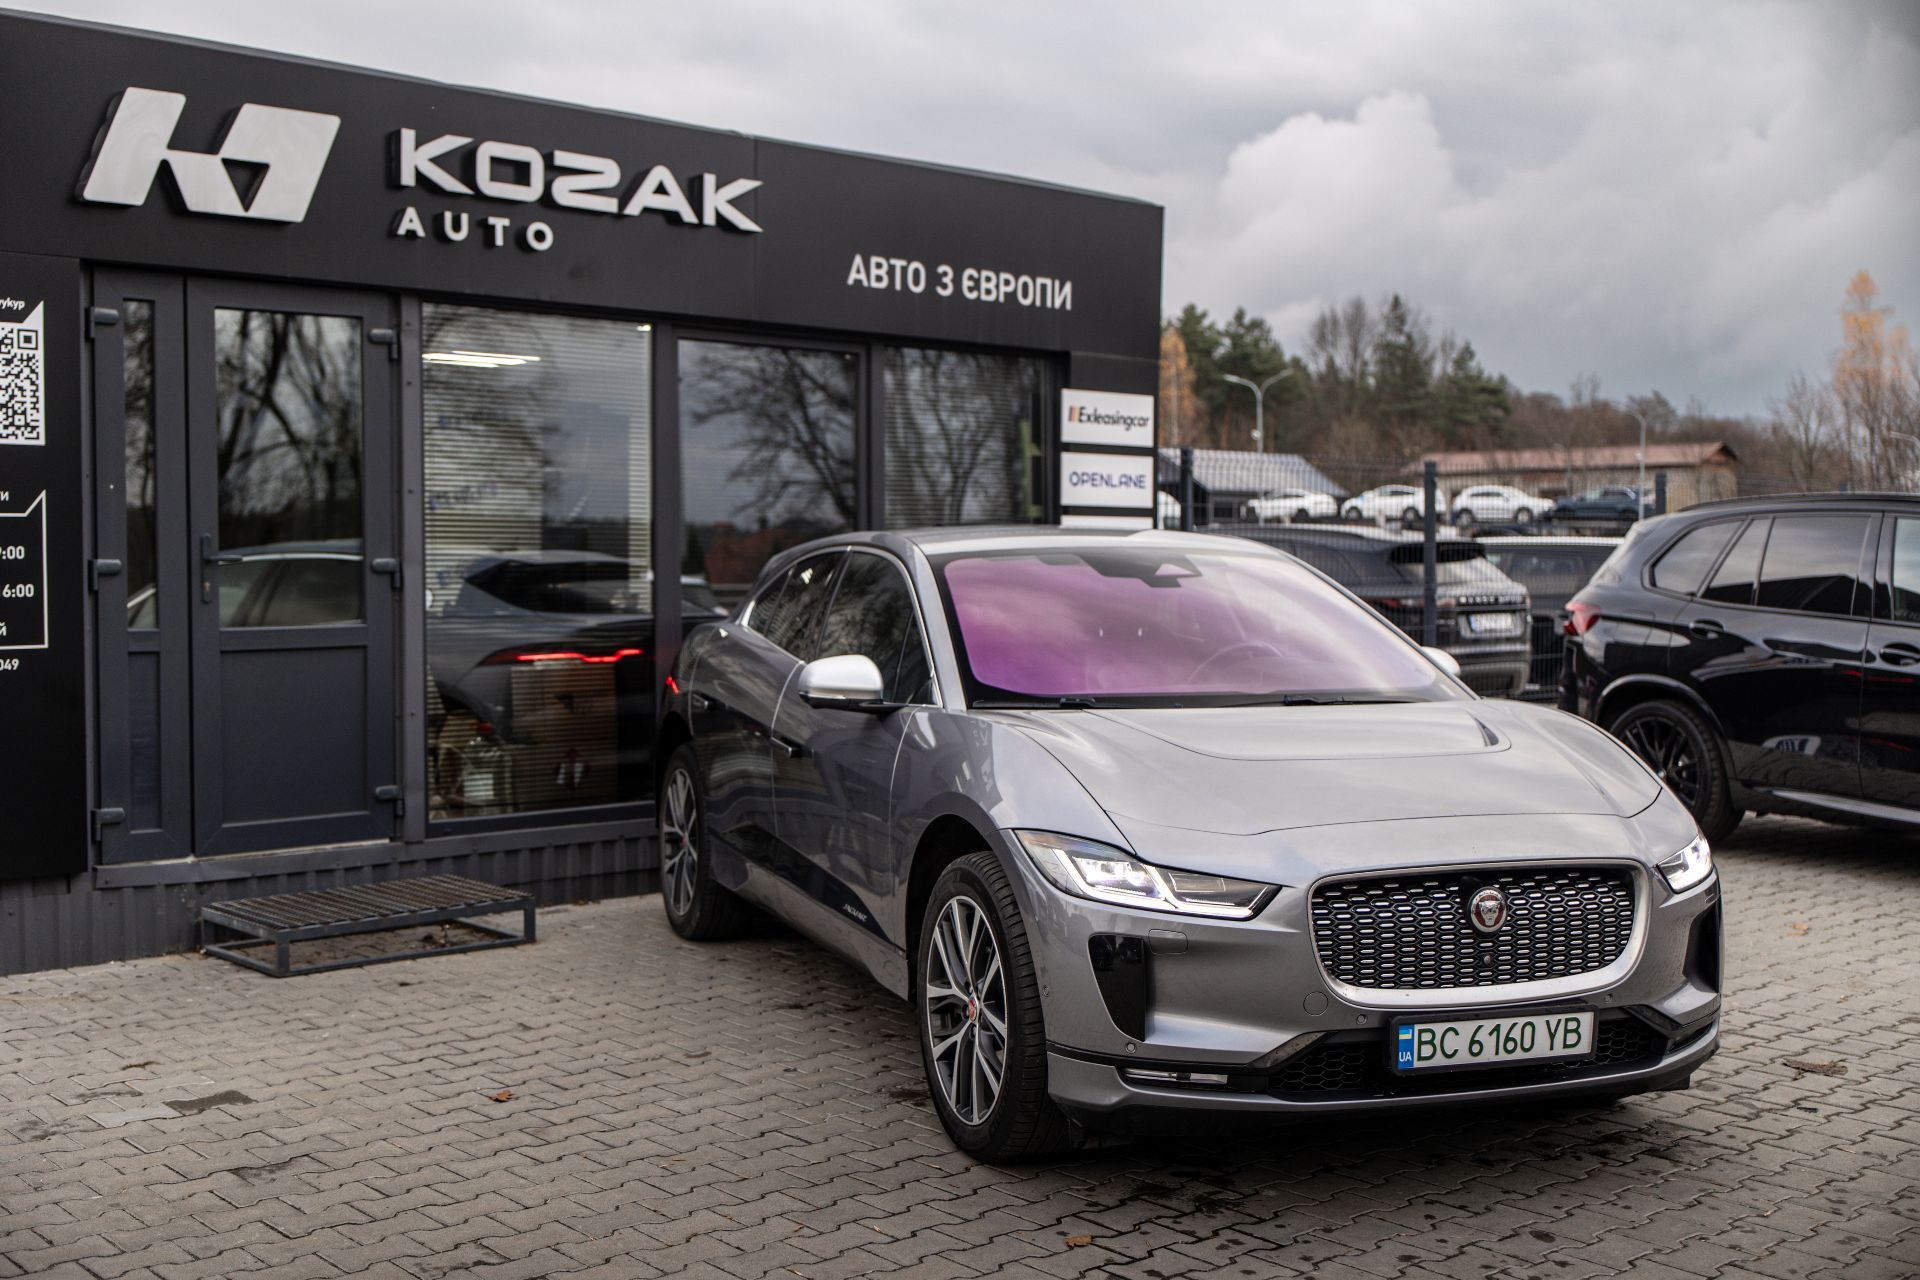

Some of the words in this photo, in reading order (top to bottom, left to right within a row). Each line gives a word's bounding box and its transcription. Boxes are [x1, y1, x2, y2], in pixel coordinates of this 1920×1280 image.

[401, 127, 764, 233] KOZAK
[396, 205, 554, 251] AUTO
[847, 253, 926, 294] АВТО
[935, 264, 954, 297] З
[961, 267, 1072, 311] ЄВРОПИ
[0, 490, 9, 501] и
[1068, 471, 1147, 489] OPENLANE
[0, 545, 25, 560] :00
[1416, 1026, 1460, 1062] BC
[1468, 1020, 1536, 1058] 6160
[1545, 1016, 1582, 1051] YB
[1398, 1051, 1412, 1062] UA
